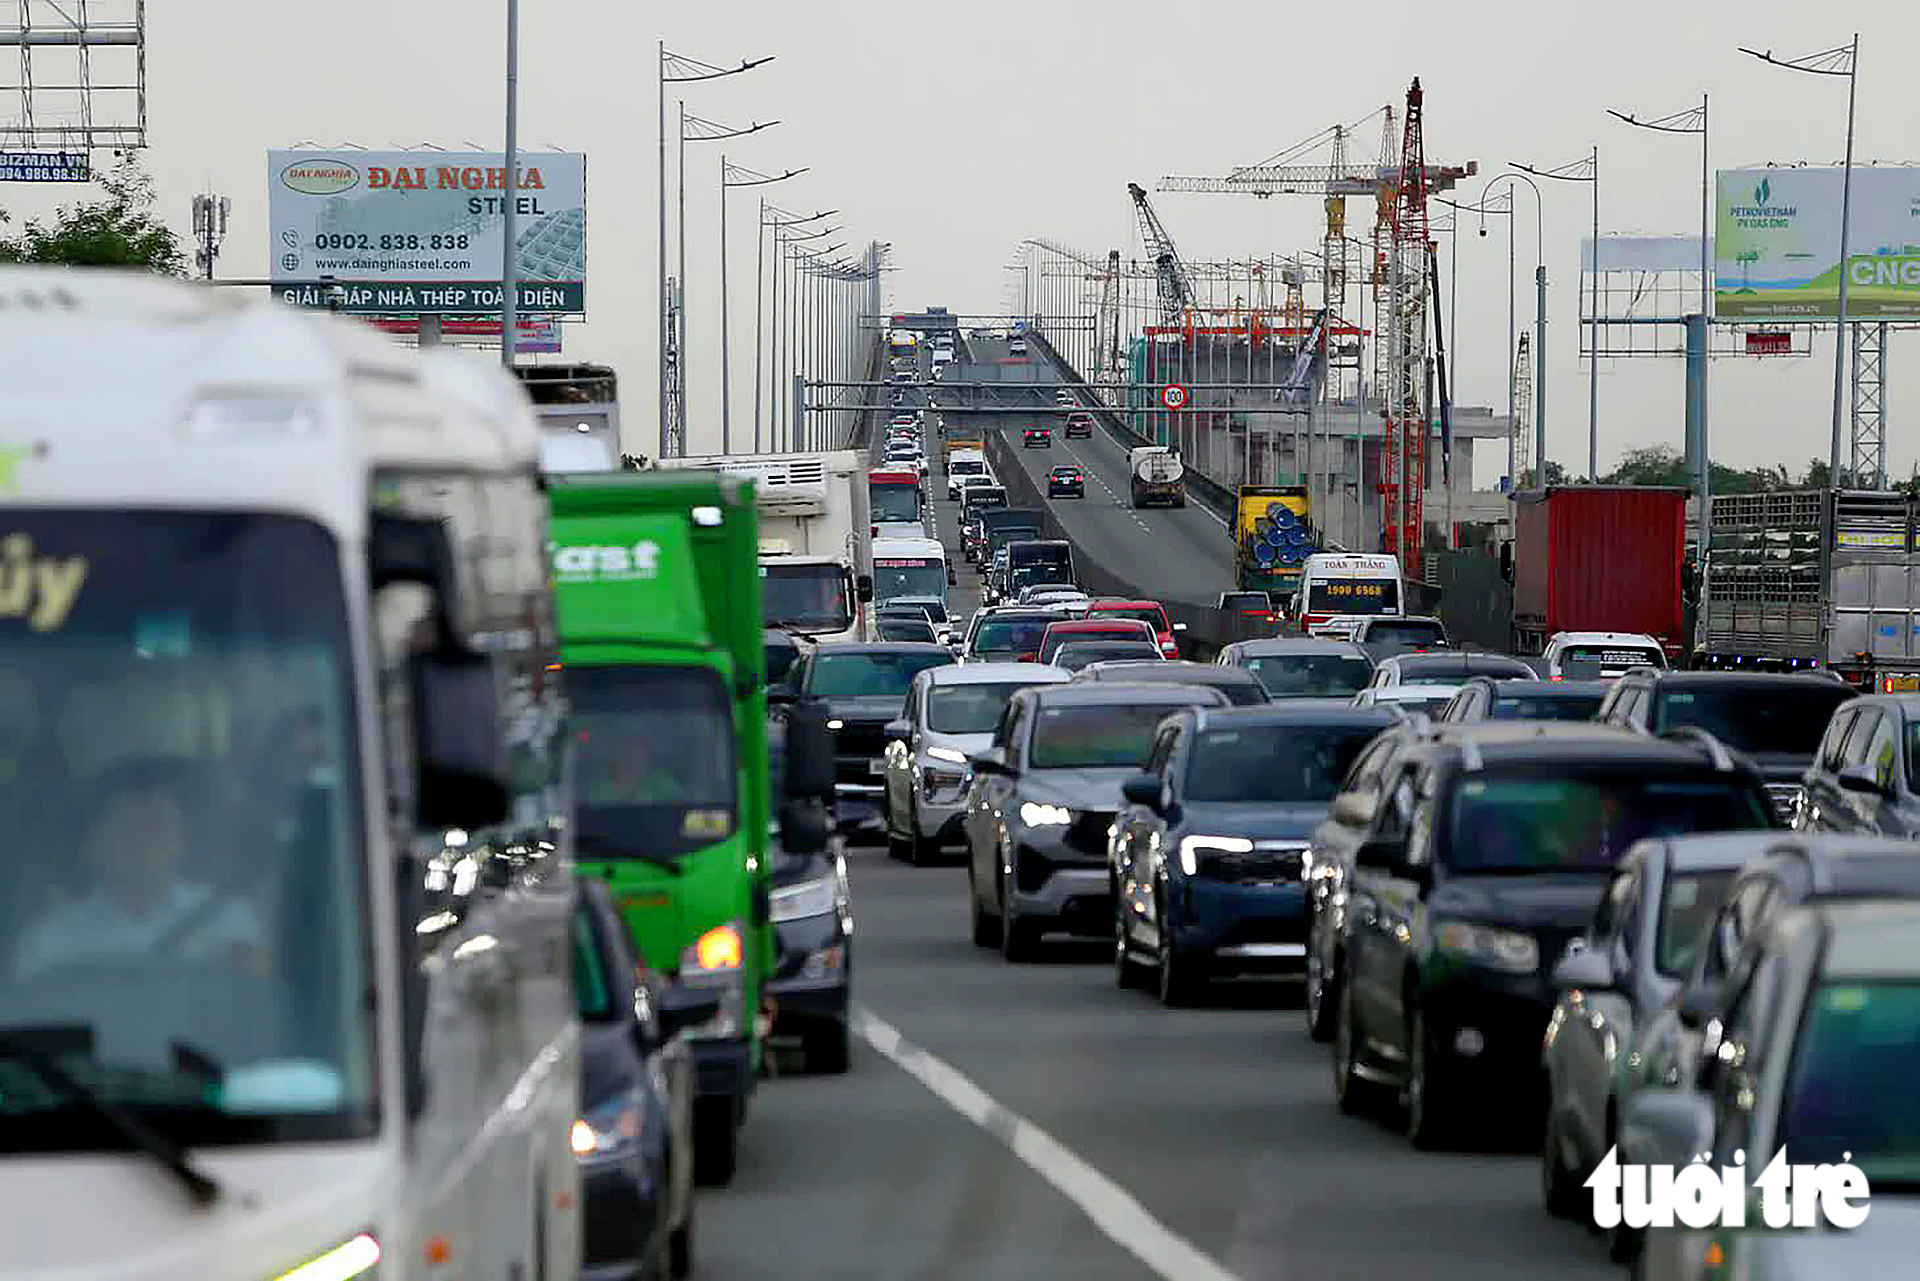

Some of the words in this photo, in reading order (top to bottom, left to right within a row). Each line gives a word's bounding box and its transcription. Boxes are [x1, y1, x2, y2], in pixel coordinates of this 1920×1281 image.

[315, 234, 374, 249] 0902.
[380, 235, 424, 249] 838.
[431, 235, 469, 249] 838
[315, 258, 471, 272] www.dainghiasteel.com
[1851, 261, 1920, 285] CNG
[283, 286, 319, 305] GIẢI
[378, 286, 416, 305] NHÀ
[420, 286, 466, 305] THÉP
[471, 286, 519, 305] TOÀ
[524, 287, 566, 308] DIỆN
[1166, 391, 1182, 402] 100
